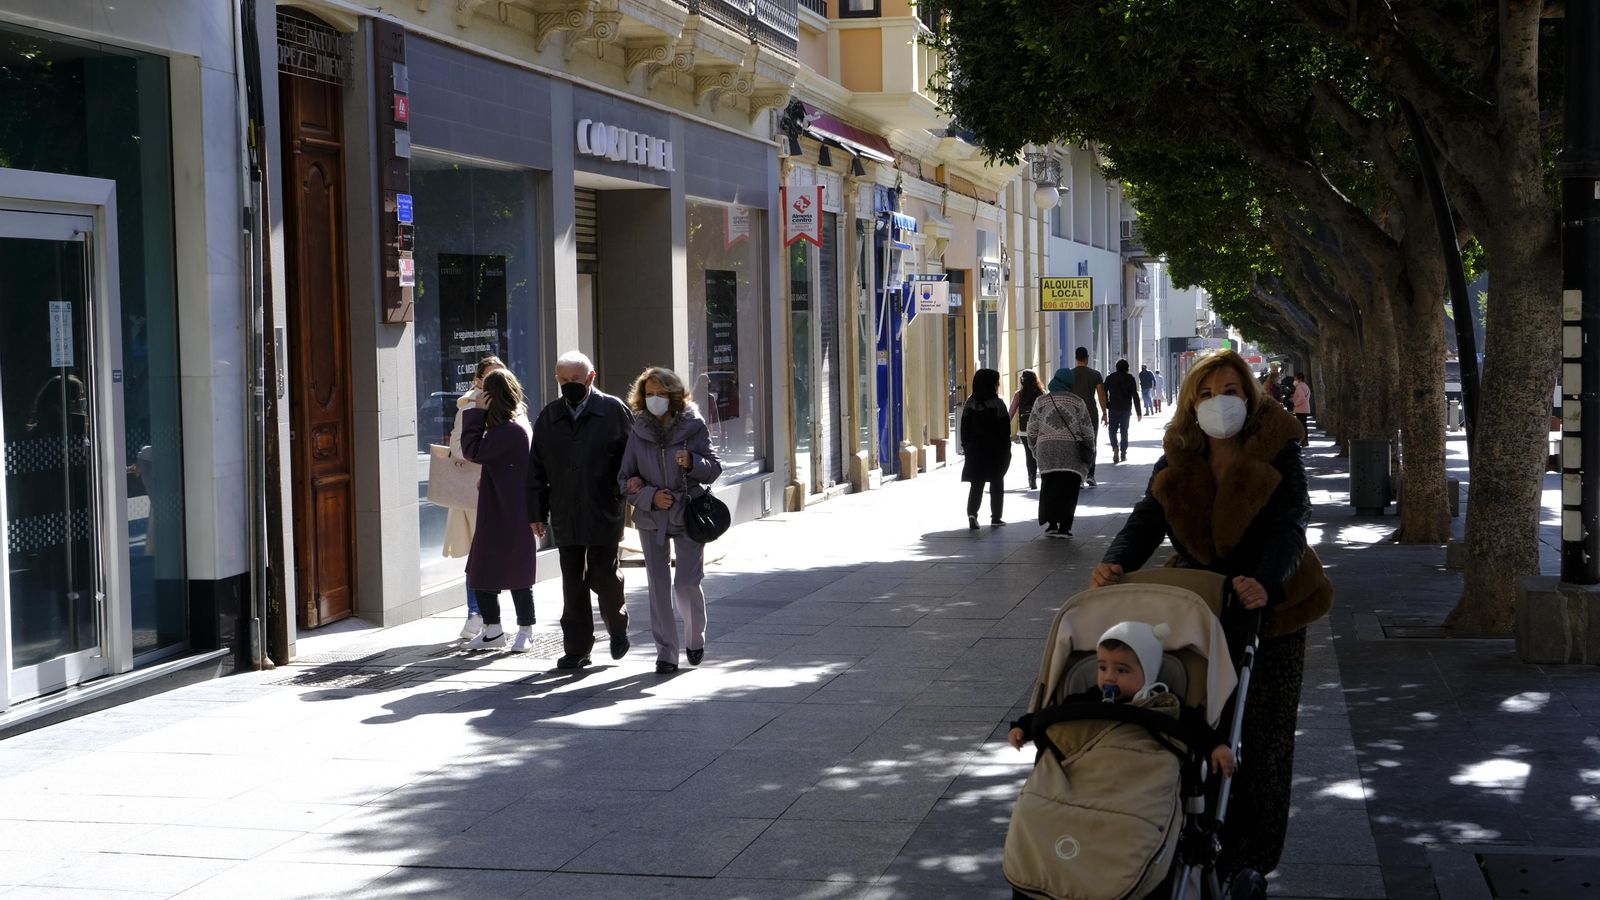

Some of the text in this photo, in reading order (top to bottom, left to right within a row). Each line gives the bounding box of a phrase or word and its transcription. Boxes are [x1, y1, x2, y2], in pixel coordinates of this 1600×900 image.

[577, 119, 675, 171] CORTEFIEL
[1044, 280, 1088, 289] ALQUILER
[456, 381, 468, 392] PASEO
